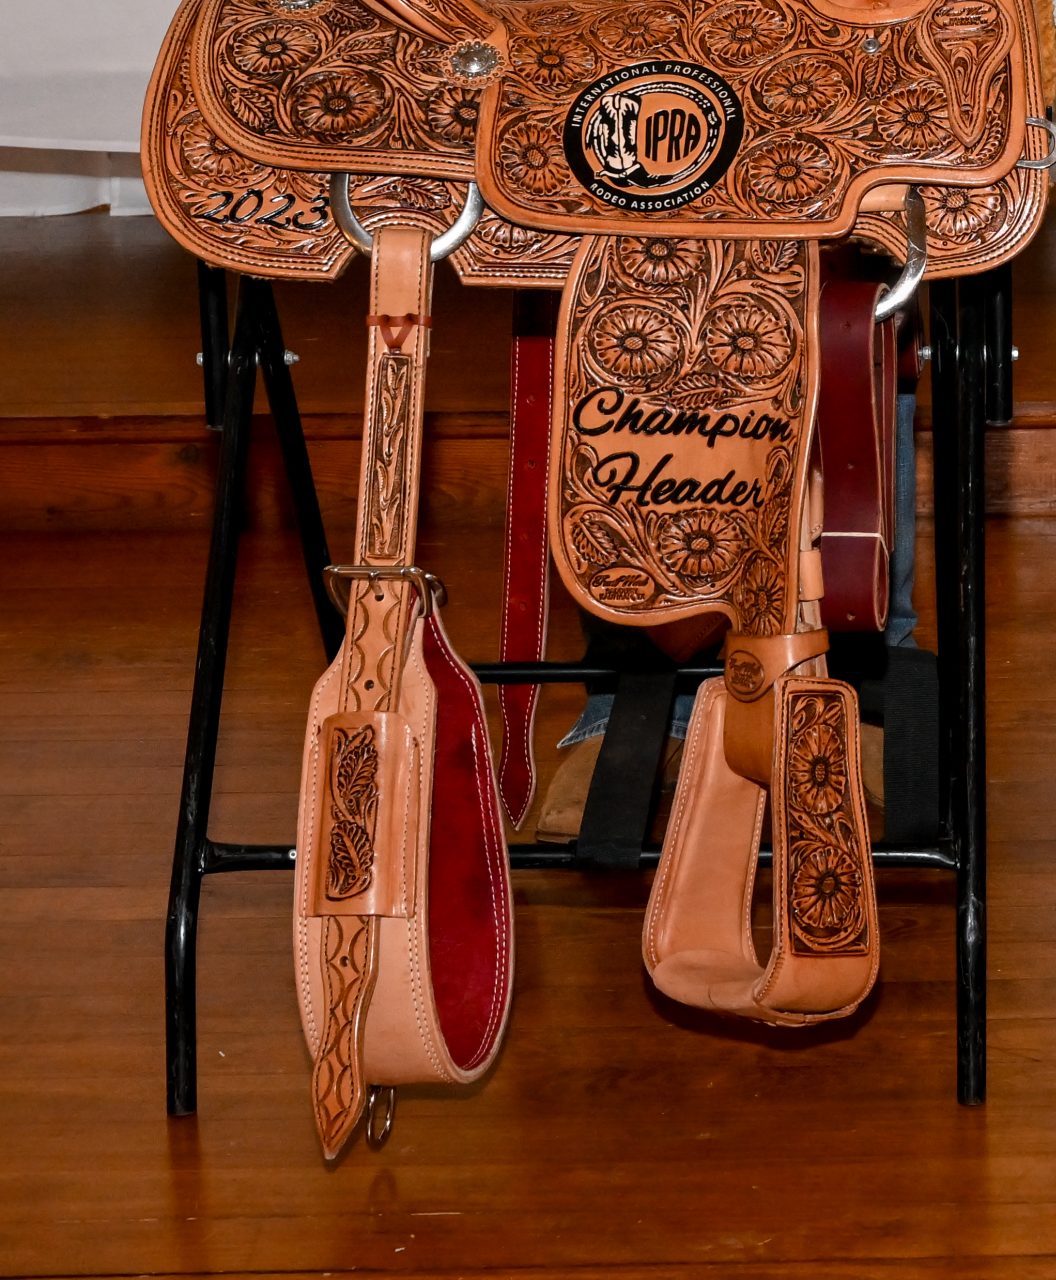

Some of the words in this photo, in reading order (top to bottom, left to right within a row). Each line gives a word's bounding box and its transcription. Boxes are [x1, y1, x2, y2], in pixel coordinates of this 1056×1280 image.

[571, 65, 658, 127] INTERNATIONAL
[664, 64, 737, 122] PROFESSIONAL
[645, 108, 701, 163] IPRA
[192, 188, 331, 230] 2023
[590, 182, 627, 207] RODEO
[631, 180, 711, 210] ASSOCIATION
[573, 385, 794, 449] Champion
[592, 451, 765, 508] Header
